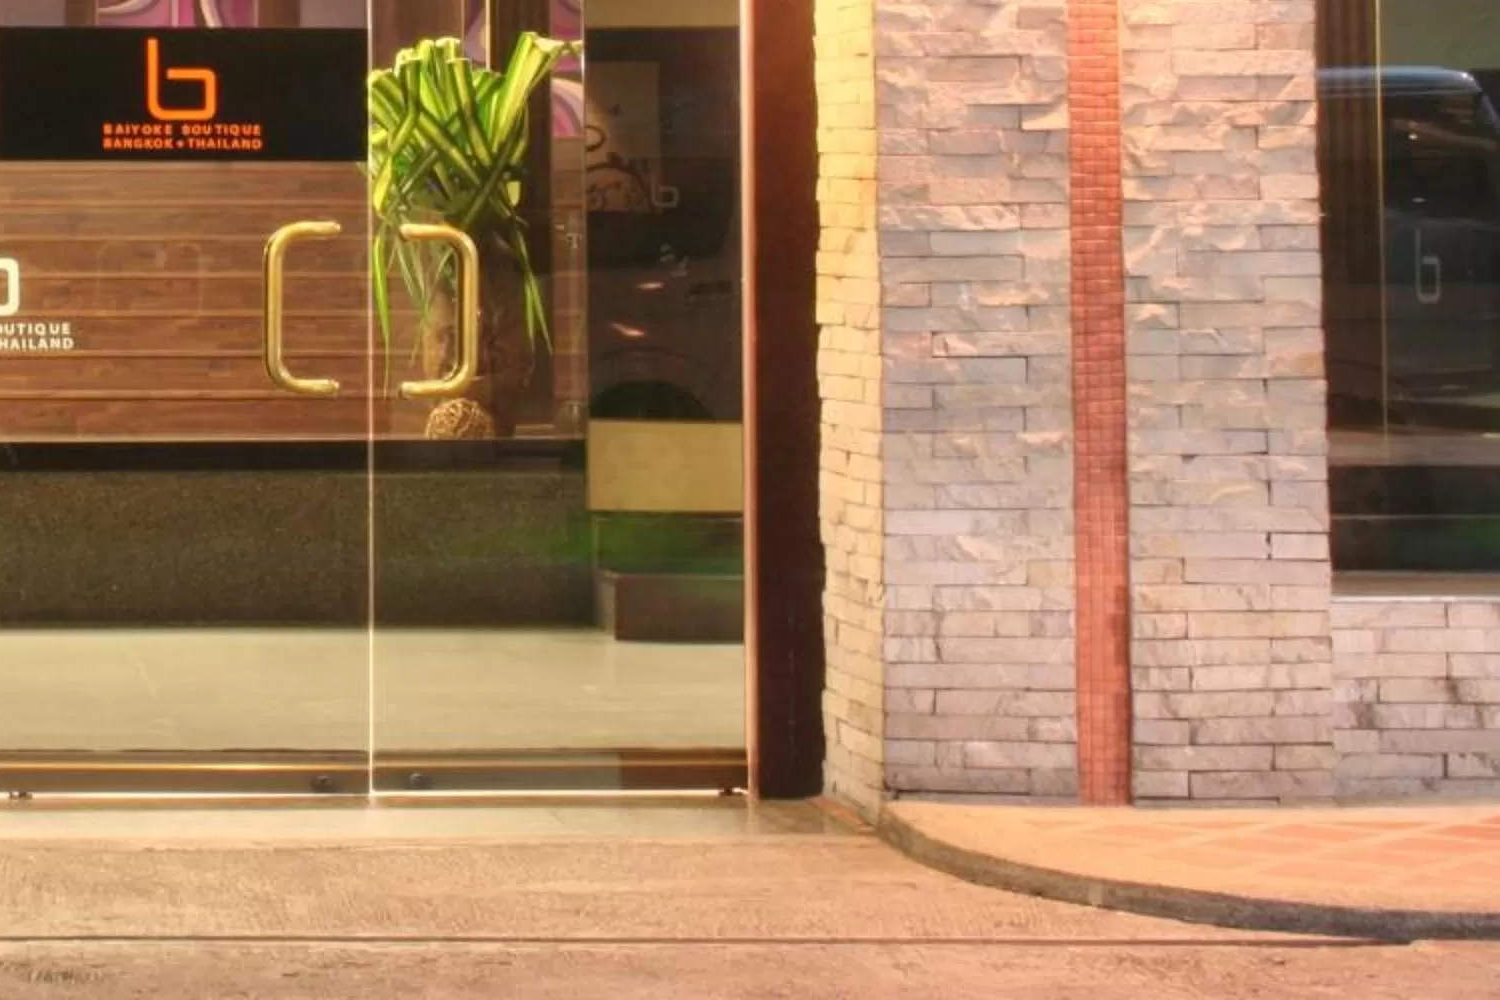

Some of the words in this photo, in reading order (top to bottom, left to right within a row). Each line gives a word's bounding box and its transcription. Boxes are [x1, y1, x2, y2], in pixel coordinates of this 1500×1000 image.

[102, 123, 173, 136] BAIYOKE
[181, 123, 262, 136] BOUTIQUE
[102, 136, 173, 150] BANGKOK
[187, 136, 263, 150] THAILAND
